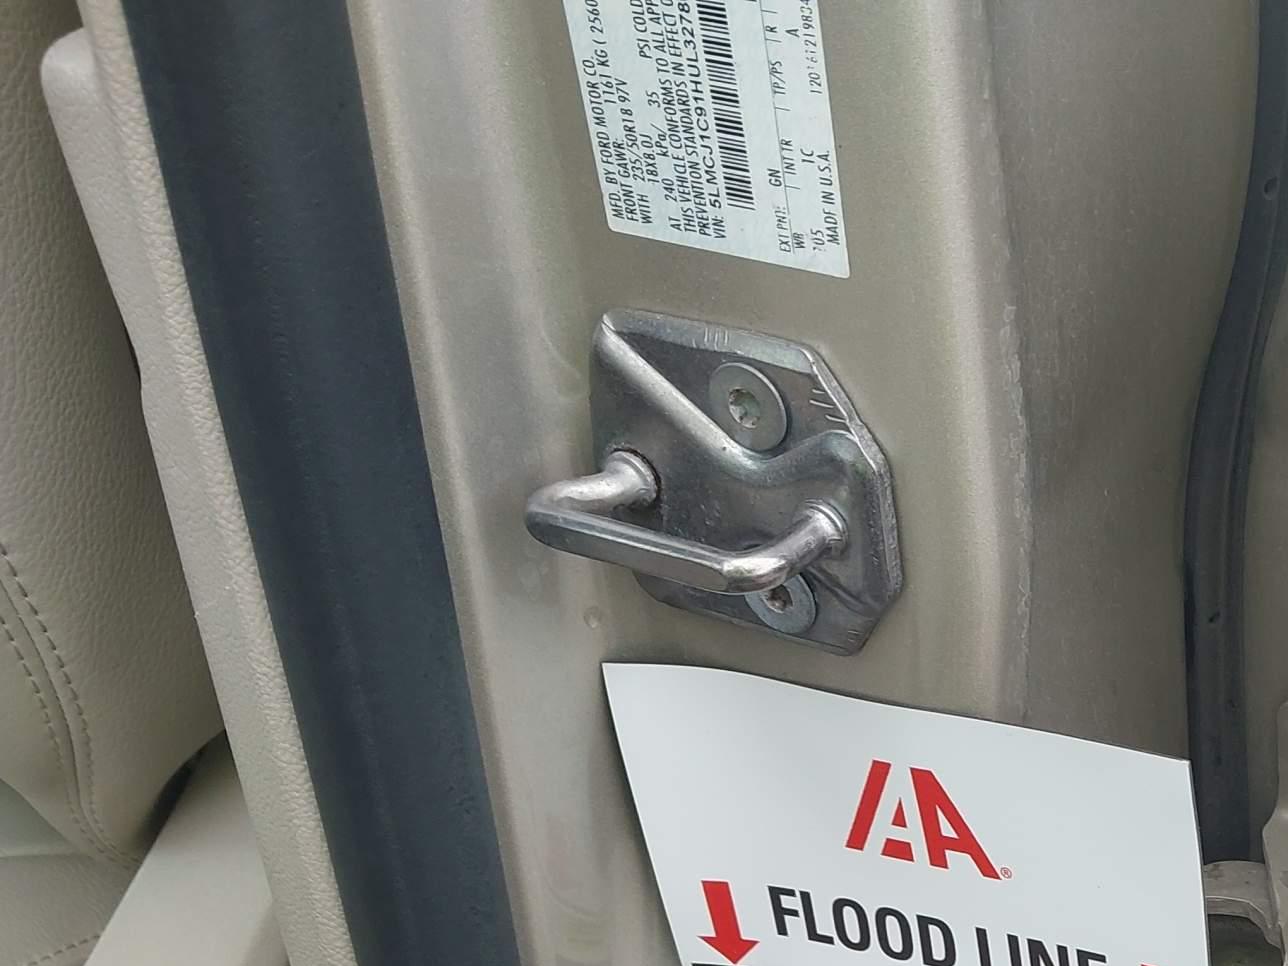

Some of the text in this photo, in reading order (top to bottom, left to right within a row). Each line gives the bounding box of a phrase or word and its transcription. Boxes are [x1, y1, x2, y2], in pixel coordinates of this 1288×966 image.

[630, 0, 647, 33] COLD
[650, 29, 666, 53] ALL
[662, 11, 682, 57] EFFECT
[765, 25, 778, 34] R
[784, 28, 800, 38] A
[595, 49, 610, 67] KG
[636, 38, 652, 59] PSI
[655, 57, 670, 73] TO
[670, 61, 686, 76] IN
[599, 74, 617, 104] 1161
[645, 90, 660, 108] 35
[658, 78, 683, 150] CONFORMS
[673, 80, 699, 157] STANDARDS
[677, 0, 726, 238] VIN: 5LMCJ1C91HUL3278
[582, 56, 625, 220] MFD. BY FORD MOTOR CO.
[780, 138, 794, 153] TR
[612, 138, 630, 178] GAWR:
[614, 78, 653, 224] WITH 235/50R18 97V
[672, 153, 692, 202] VEHICLE
[767, 168, 782, 187] GN
[782, 155, 797, 175] INT
[816, 150, 833, 187] U.S.A.
[619, 182, 639, 222] FRONT
[661, 178, 677, 202] 240
[687, 160, 712, 236] PREVENTION
[820, 190, 836, 205] IN
[668, 215, 682, 232] AT
[681, 206, 697, 232] THIS
